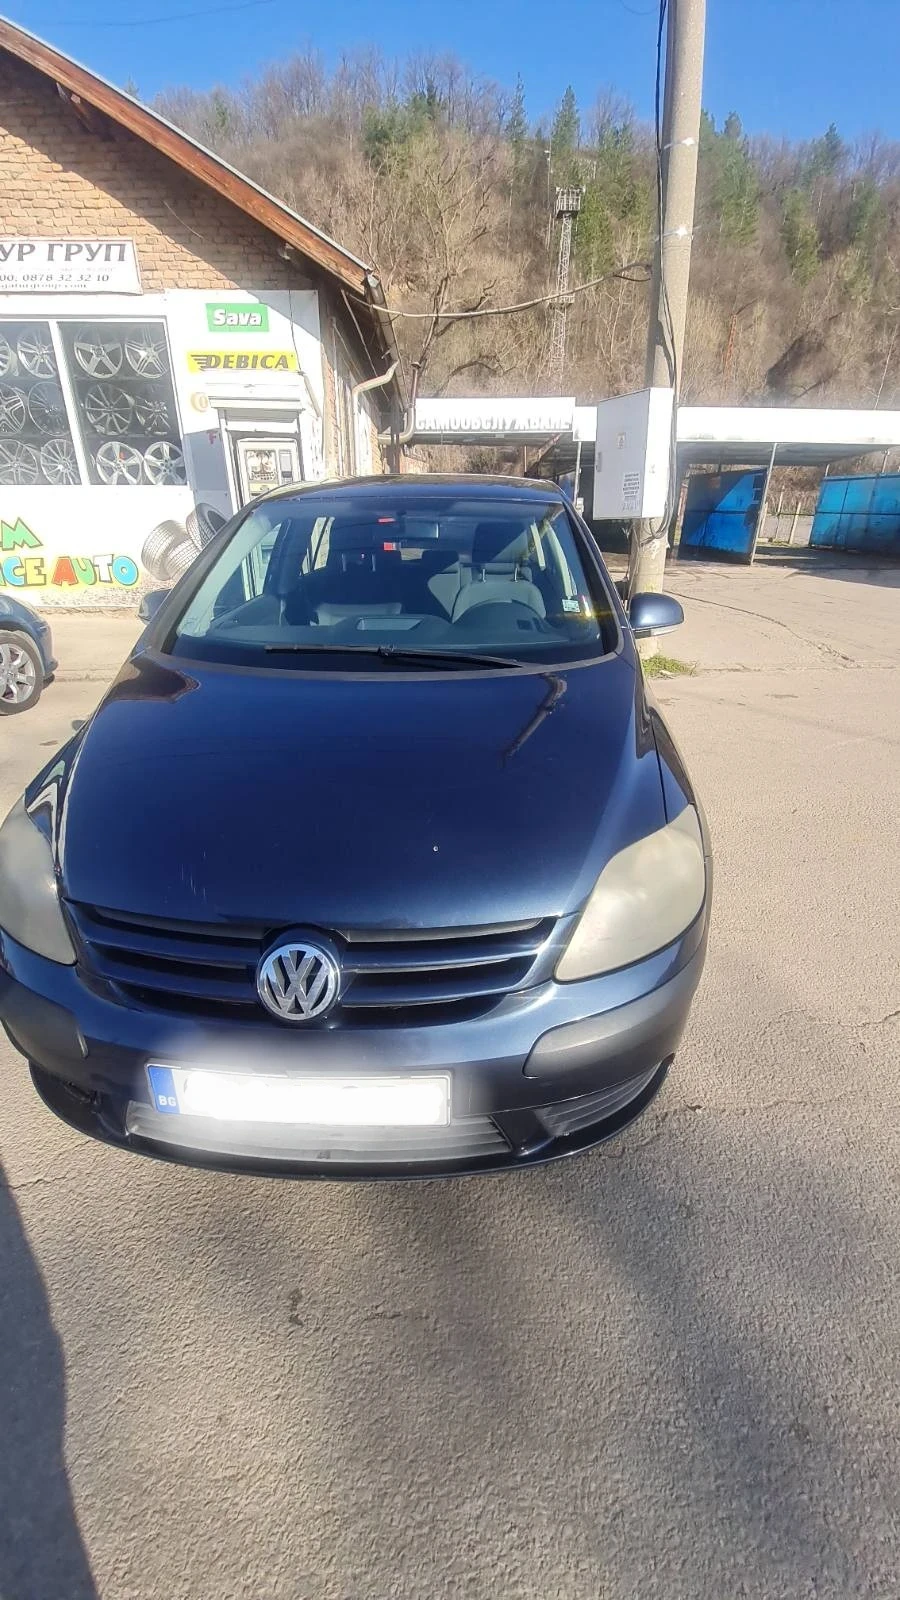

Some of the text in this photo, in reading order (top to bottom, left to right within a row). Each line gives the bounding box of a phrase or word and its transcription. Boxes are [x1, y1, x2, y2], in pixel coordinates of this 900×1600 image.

[47, 243, 127, 262] ГРУП
[22, 273, 53, 282] 0878
[56, 273, 72, 282] 32
[76, 273, 92, 282] 32
[97, 273, 110, 282] 10
[213, 308, 262, 326] Sava
[203, 354, 289, 369] DEBICA
[0, 516, 44, 551] M
[0, 553, 139, 587] CE AUTO
[158, 1094, 177, 1107] BG
